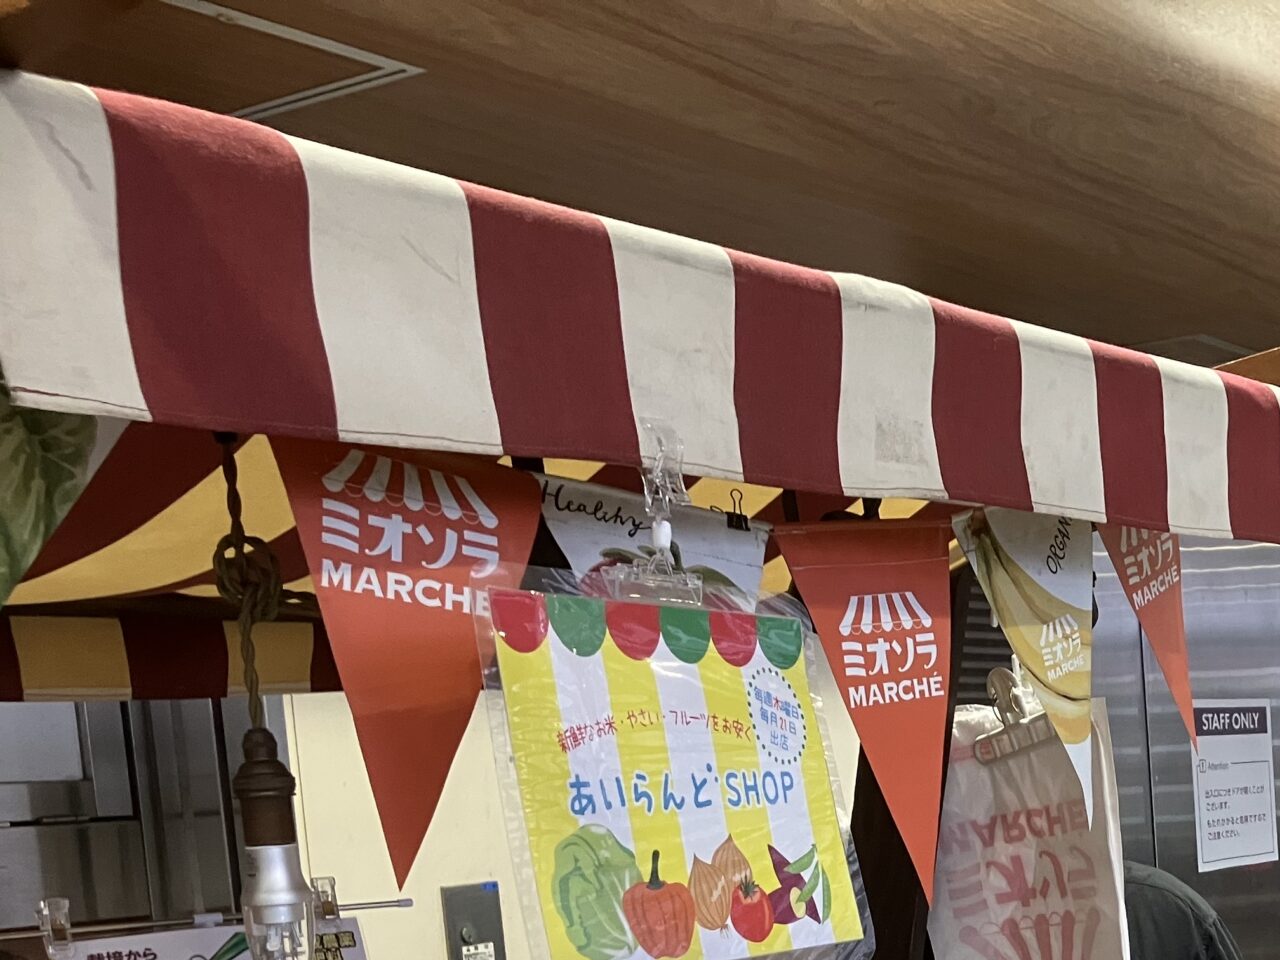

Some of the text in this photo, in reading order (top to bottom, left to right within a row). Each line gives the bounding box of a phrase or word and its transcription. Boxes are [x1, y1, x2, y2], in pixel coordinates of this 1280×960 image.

[322, 498, 499, 578] ミオソラ
[1046, 515, 1073, 575] ORGAN
[1124, 532, 1173, 586] ミオソラ
[842, 632, 938, 677] ミオソラ
[1041, 632, 1082, 667] ミオソラ
[848, 672, 945, 709] MARCHÉ
[770, 729, 789, 751] 出店
[1202, 712, 1259, 731] STAFF ONLY
